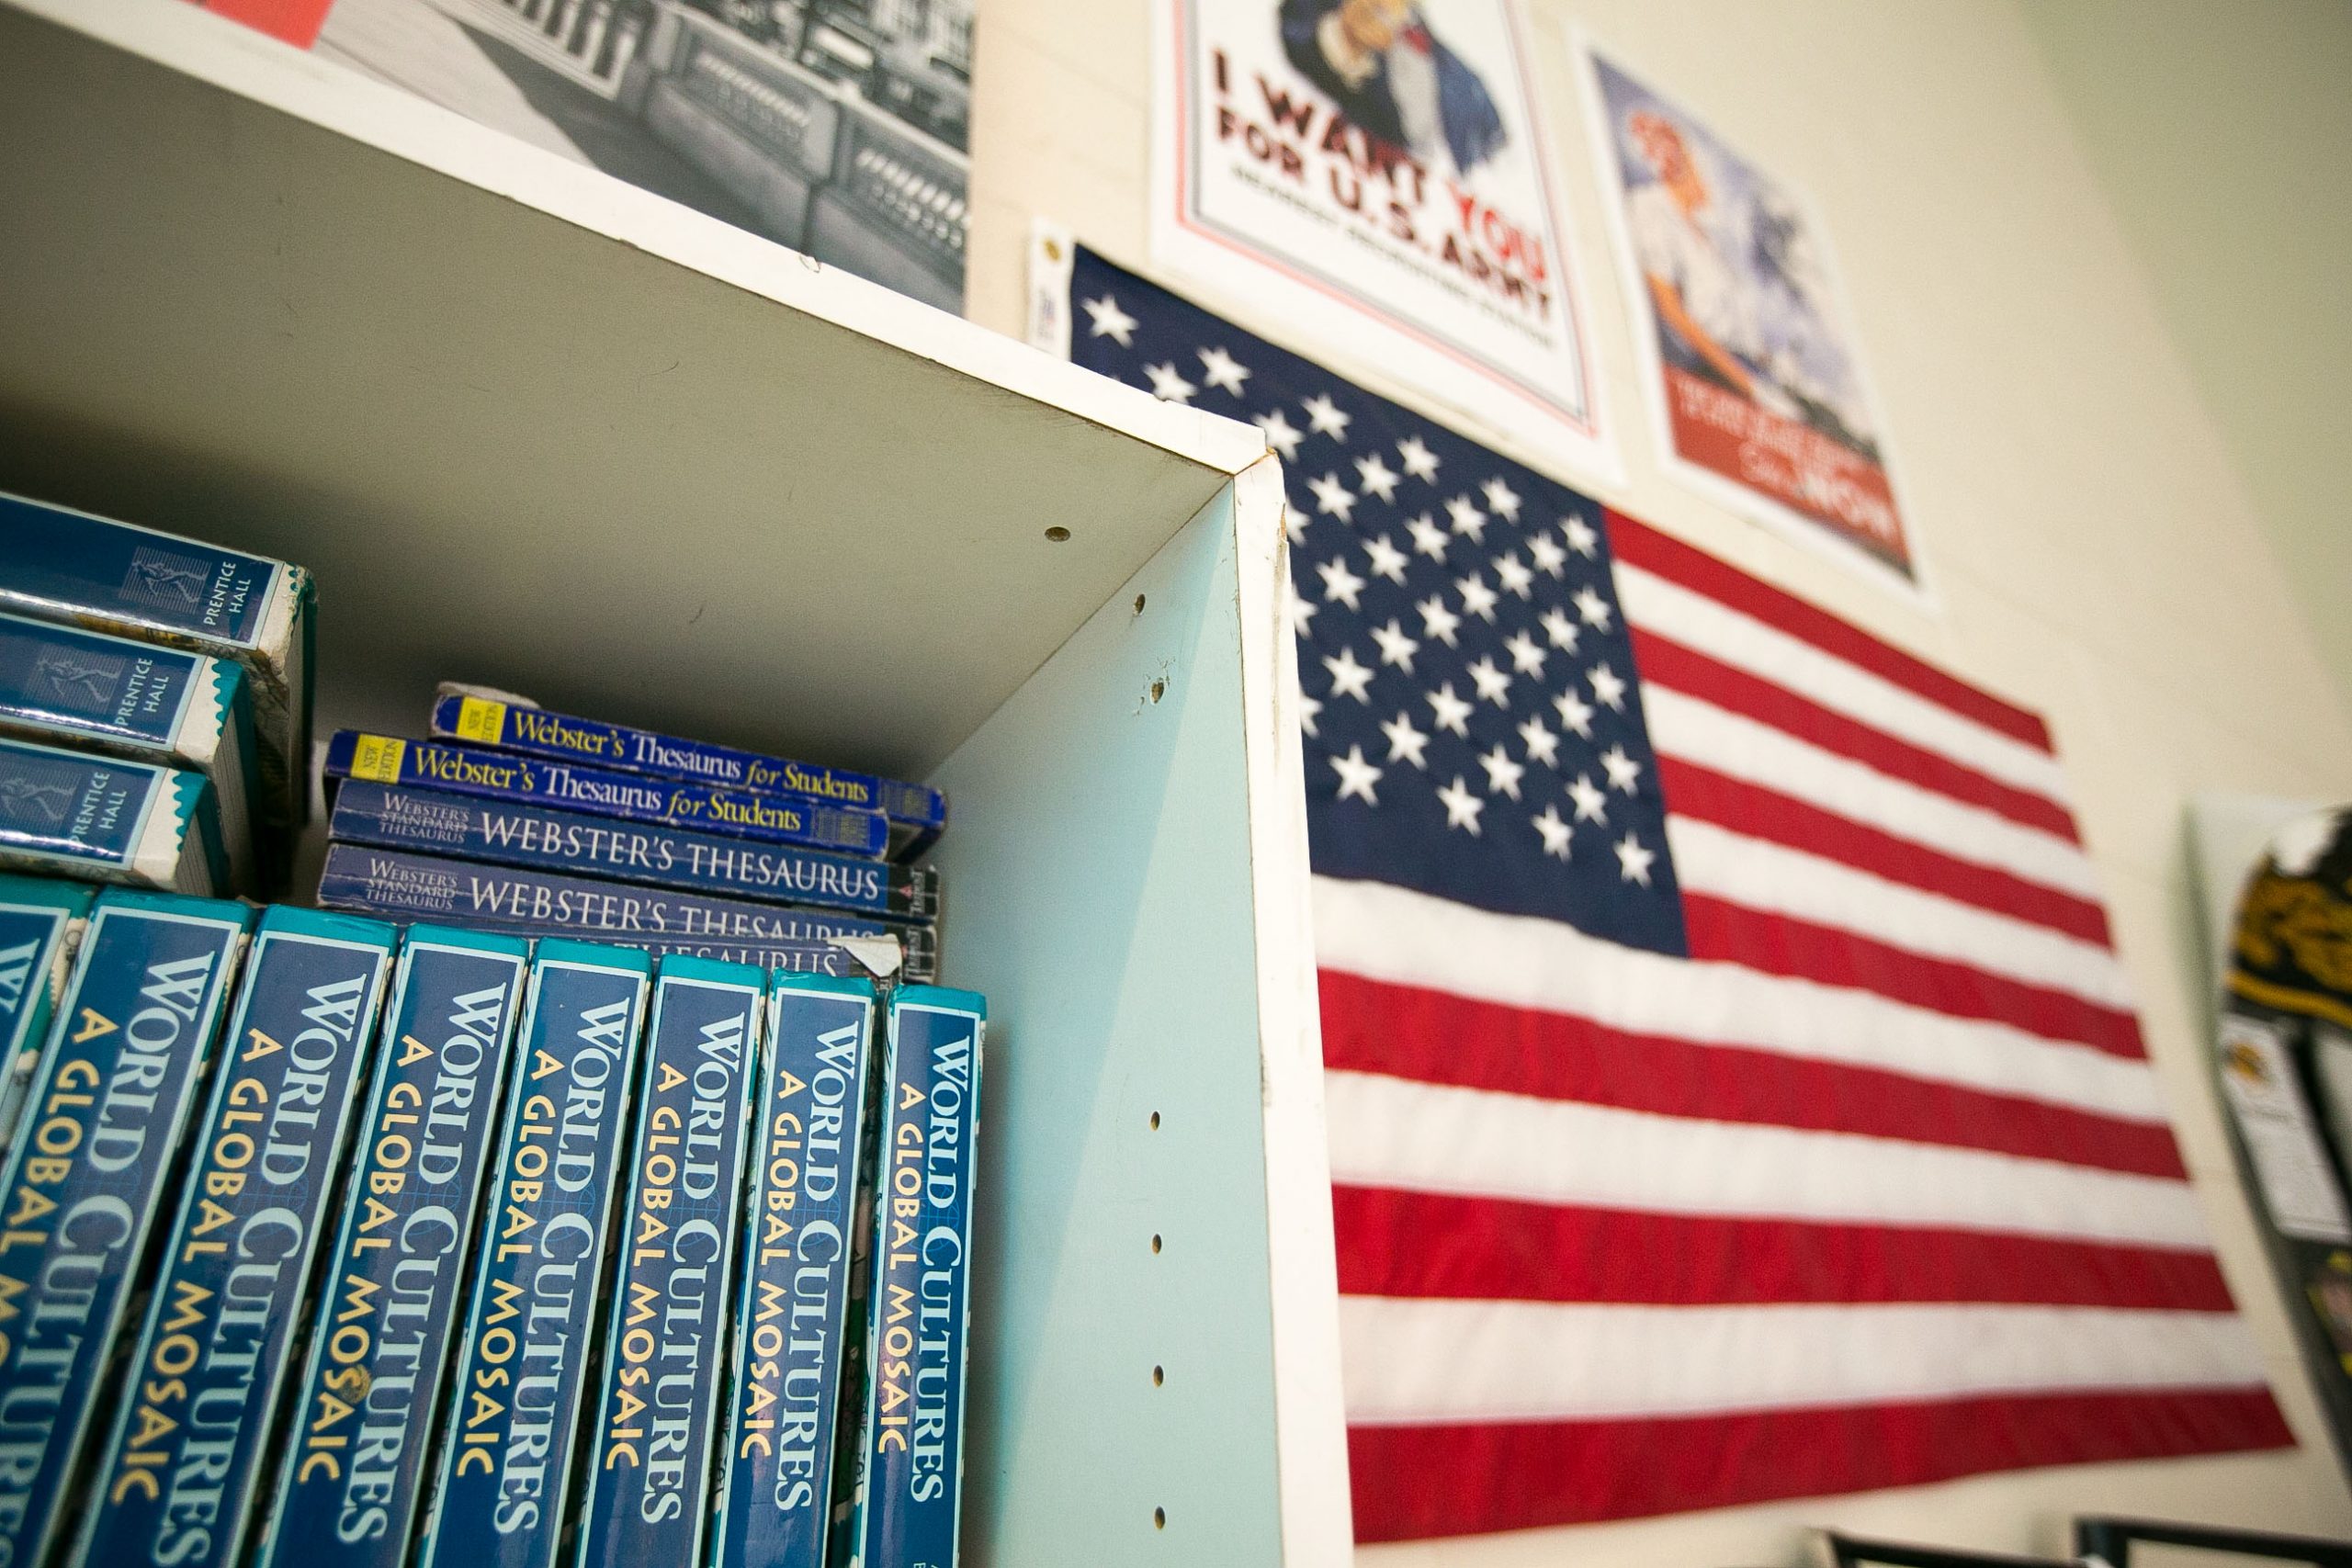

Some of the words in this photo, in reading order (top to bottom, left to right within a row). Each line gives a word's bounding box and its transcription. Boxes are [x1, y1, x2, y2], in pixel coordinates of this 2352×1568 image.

[1213, 48, 1232, 95] I
[1254, 72, 1428, 204] WANT
[1446, 180, 1547, 282] YOU
[1216, 104, 1306, 183] FOR
[203, 560, 237, 626] PRENTICE
[229, 577, 253, 615] HALL
[115, 657, 154, 728] PRENTICE
[144, 673, 169, 713] HALL
[514, 708, 625, 759] Webster's
[632, 734, 741, 778] Thesaurus
[746, 760, 782, 787] for
[784, 762, 869, 803] Students
[69, 770, 111, 844] PRENTICE
[99, 788, 128, 830] HALL
[379, 821, 466, 843] THESAURUS
[416, 746, 535, 792] Webster's
[543, 766, 662, 811] Thesaurus
[668, 792, 706, 818] for
[708, 795, 801, 831] Students
[481, 811, 674, 869] WEBSTER'S
[686, 842, 880, 900] THESAURUS
[366, 888, 454, 911] THESAURUS
[368, 877, 456, 898] STANDARD
[469, 875, 666, 933] WEBSTER'S
[680, 906, 874, 941] THESAUR
[71, 1008, 119, 1043] A
[87, 951, 215, 1172] WORLD
[241, 1028, 284, 1063] A
[259, 973, 368, 1186] WORLD
[397, 1034, 435, 1067] A
[417, 981, 507, 1186] WORLD
[530, 1049, 565, 1081] A
[554, 997, 630, 1192] WORLD
[656, 1062, 688, 1093] A
[682, 1011, 746, 1201] WORLD
[777, 1070, 807, 1100] A
[899, 1082, 927, 1111] A
[0, 1059, 100, 1254] GLOBAL
[183, 1077, 268, 1263] GLOBAL
[352, 1082, 423, 1259] GLOBAL
[496, 1094, 557, 1264] GLOBAL
[631, 1106, 683, 1268] GLOBAL
[760, 1111, 804, 1267] GLOBAL
[804, 1020, 860, 1203] WORLD
[888, 1122, 925, 1271] GLOBAL
[923, 1034, 969, 1210] WORLD
[0, 1193, 134, 1568] CULTUR
[111, 1280, 215, 1505] MOSAIC
[153, 1206, 305, 1567] CULTURES
[299, 1273, 382, 1484] MOSAIC
[336, 1205, 443, 1545] CULTURES
[457, 1278, 523, 1477] MOSAIC
[494, 1212, 595, 1534] CULTURES
[605, 1280, 662, 1471] MOSAIC
[643, 1218, 722, 1525] CULTURES
[740, 1280, 786, 1461] MOSAIC
[774, 1220, 842, 1512] CULTURES
[877, 1283, 915, 1455] MOSAIC
[910, 1225, 962, 1503] CULTURES
